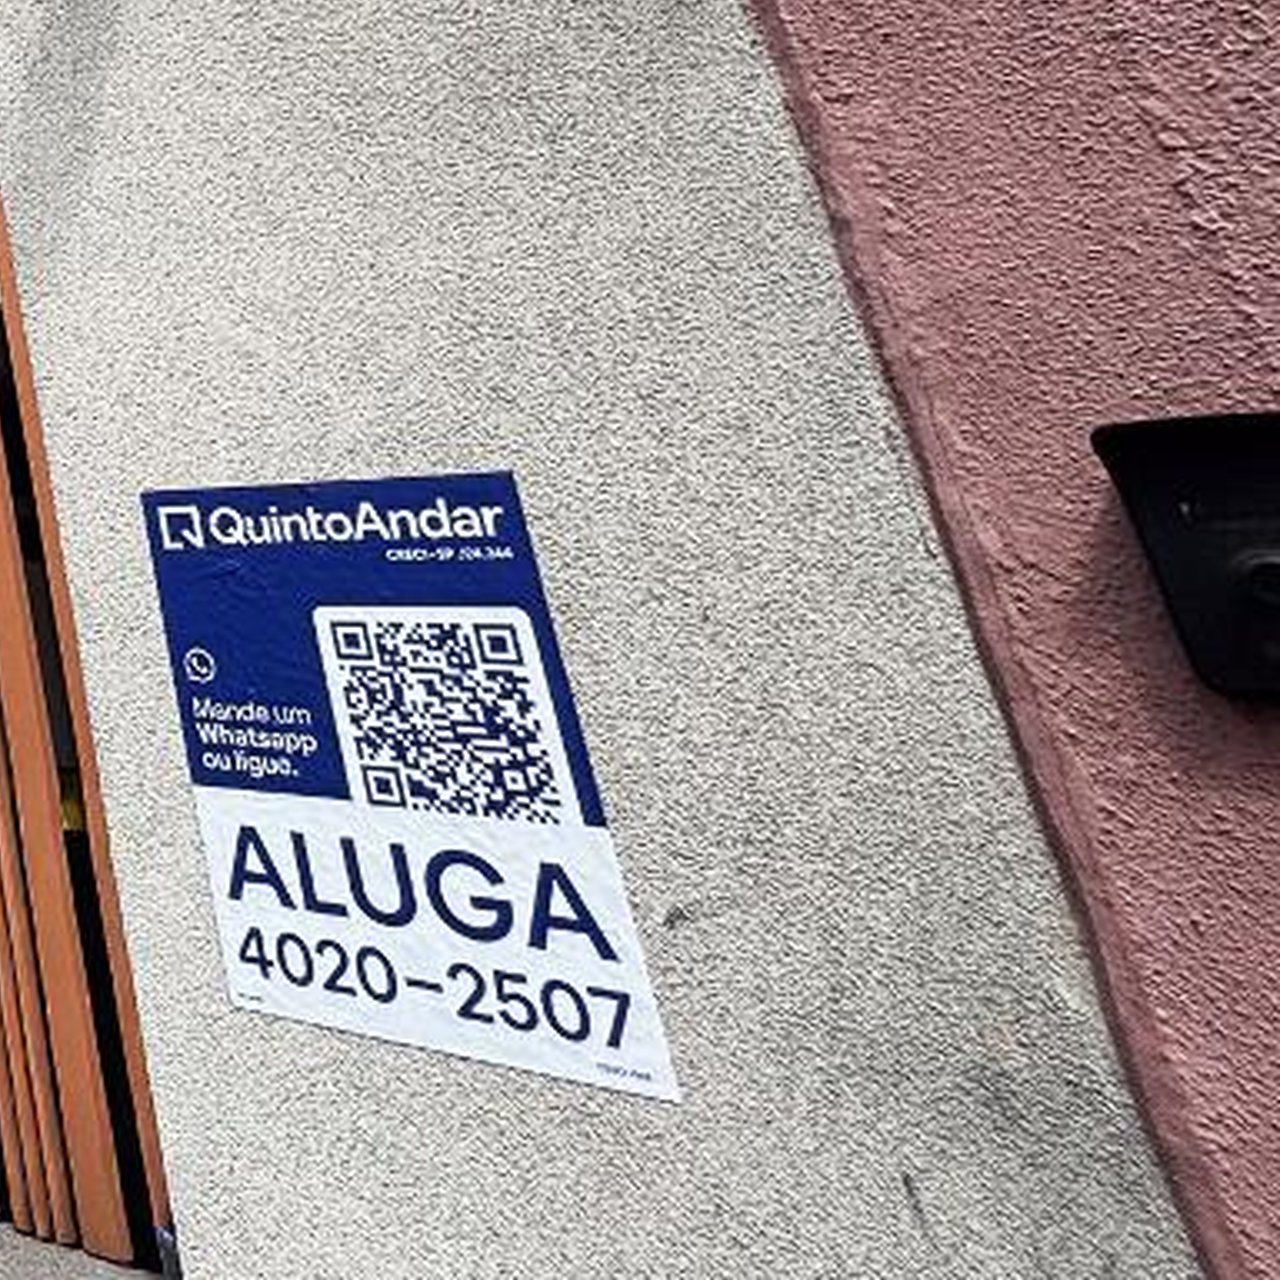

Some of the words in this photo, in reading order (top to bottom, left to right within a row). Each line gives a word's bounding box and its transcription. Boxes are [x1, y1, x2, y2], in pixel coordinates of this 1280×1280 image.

[208, 497, 503, 546] QuintoAndar
[273, 705, 312, 725] um
[195, 722, 318, 757] Whatsapp
[202, 751, 232, 770] ou
[227, 824, 621, 963] ALUGA
[238, 926, 631, 1049] 4020-2507
